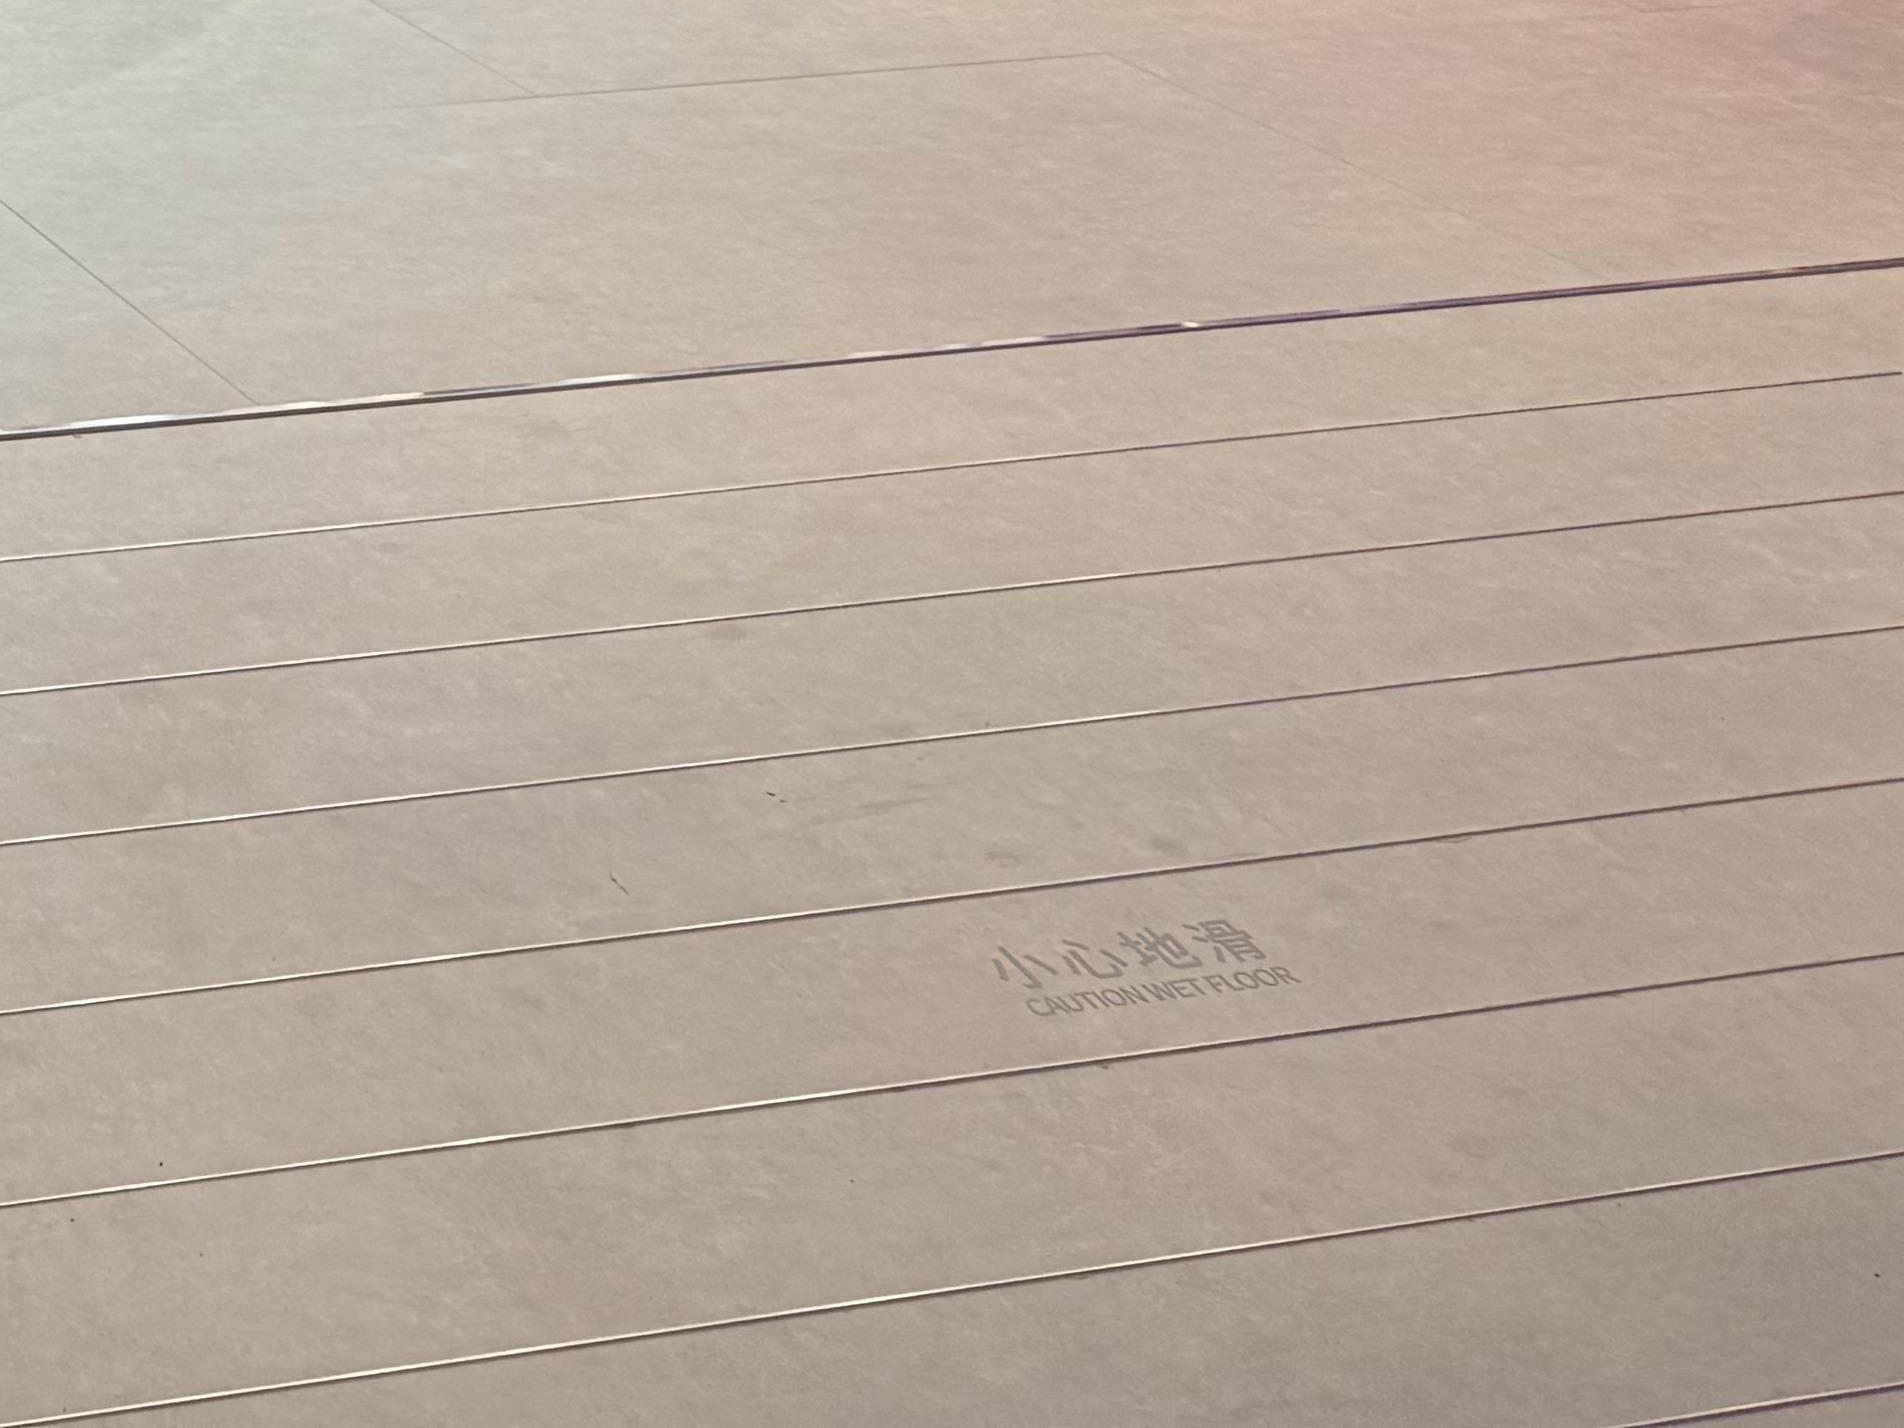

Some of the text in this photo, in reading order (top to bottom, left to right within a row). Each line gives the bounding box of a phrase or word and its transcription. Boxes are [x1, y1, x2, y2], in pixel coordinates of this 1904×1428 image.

[992, 919, 1267, 990] 小心地滑
[1025, 965, 1301, 1017] CAUTION WET FLOOR
